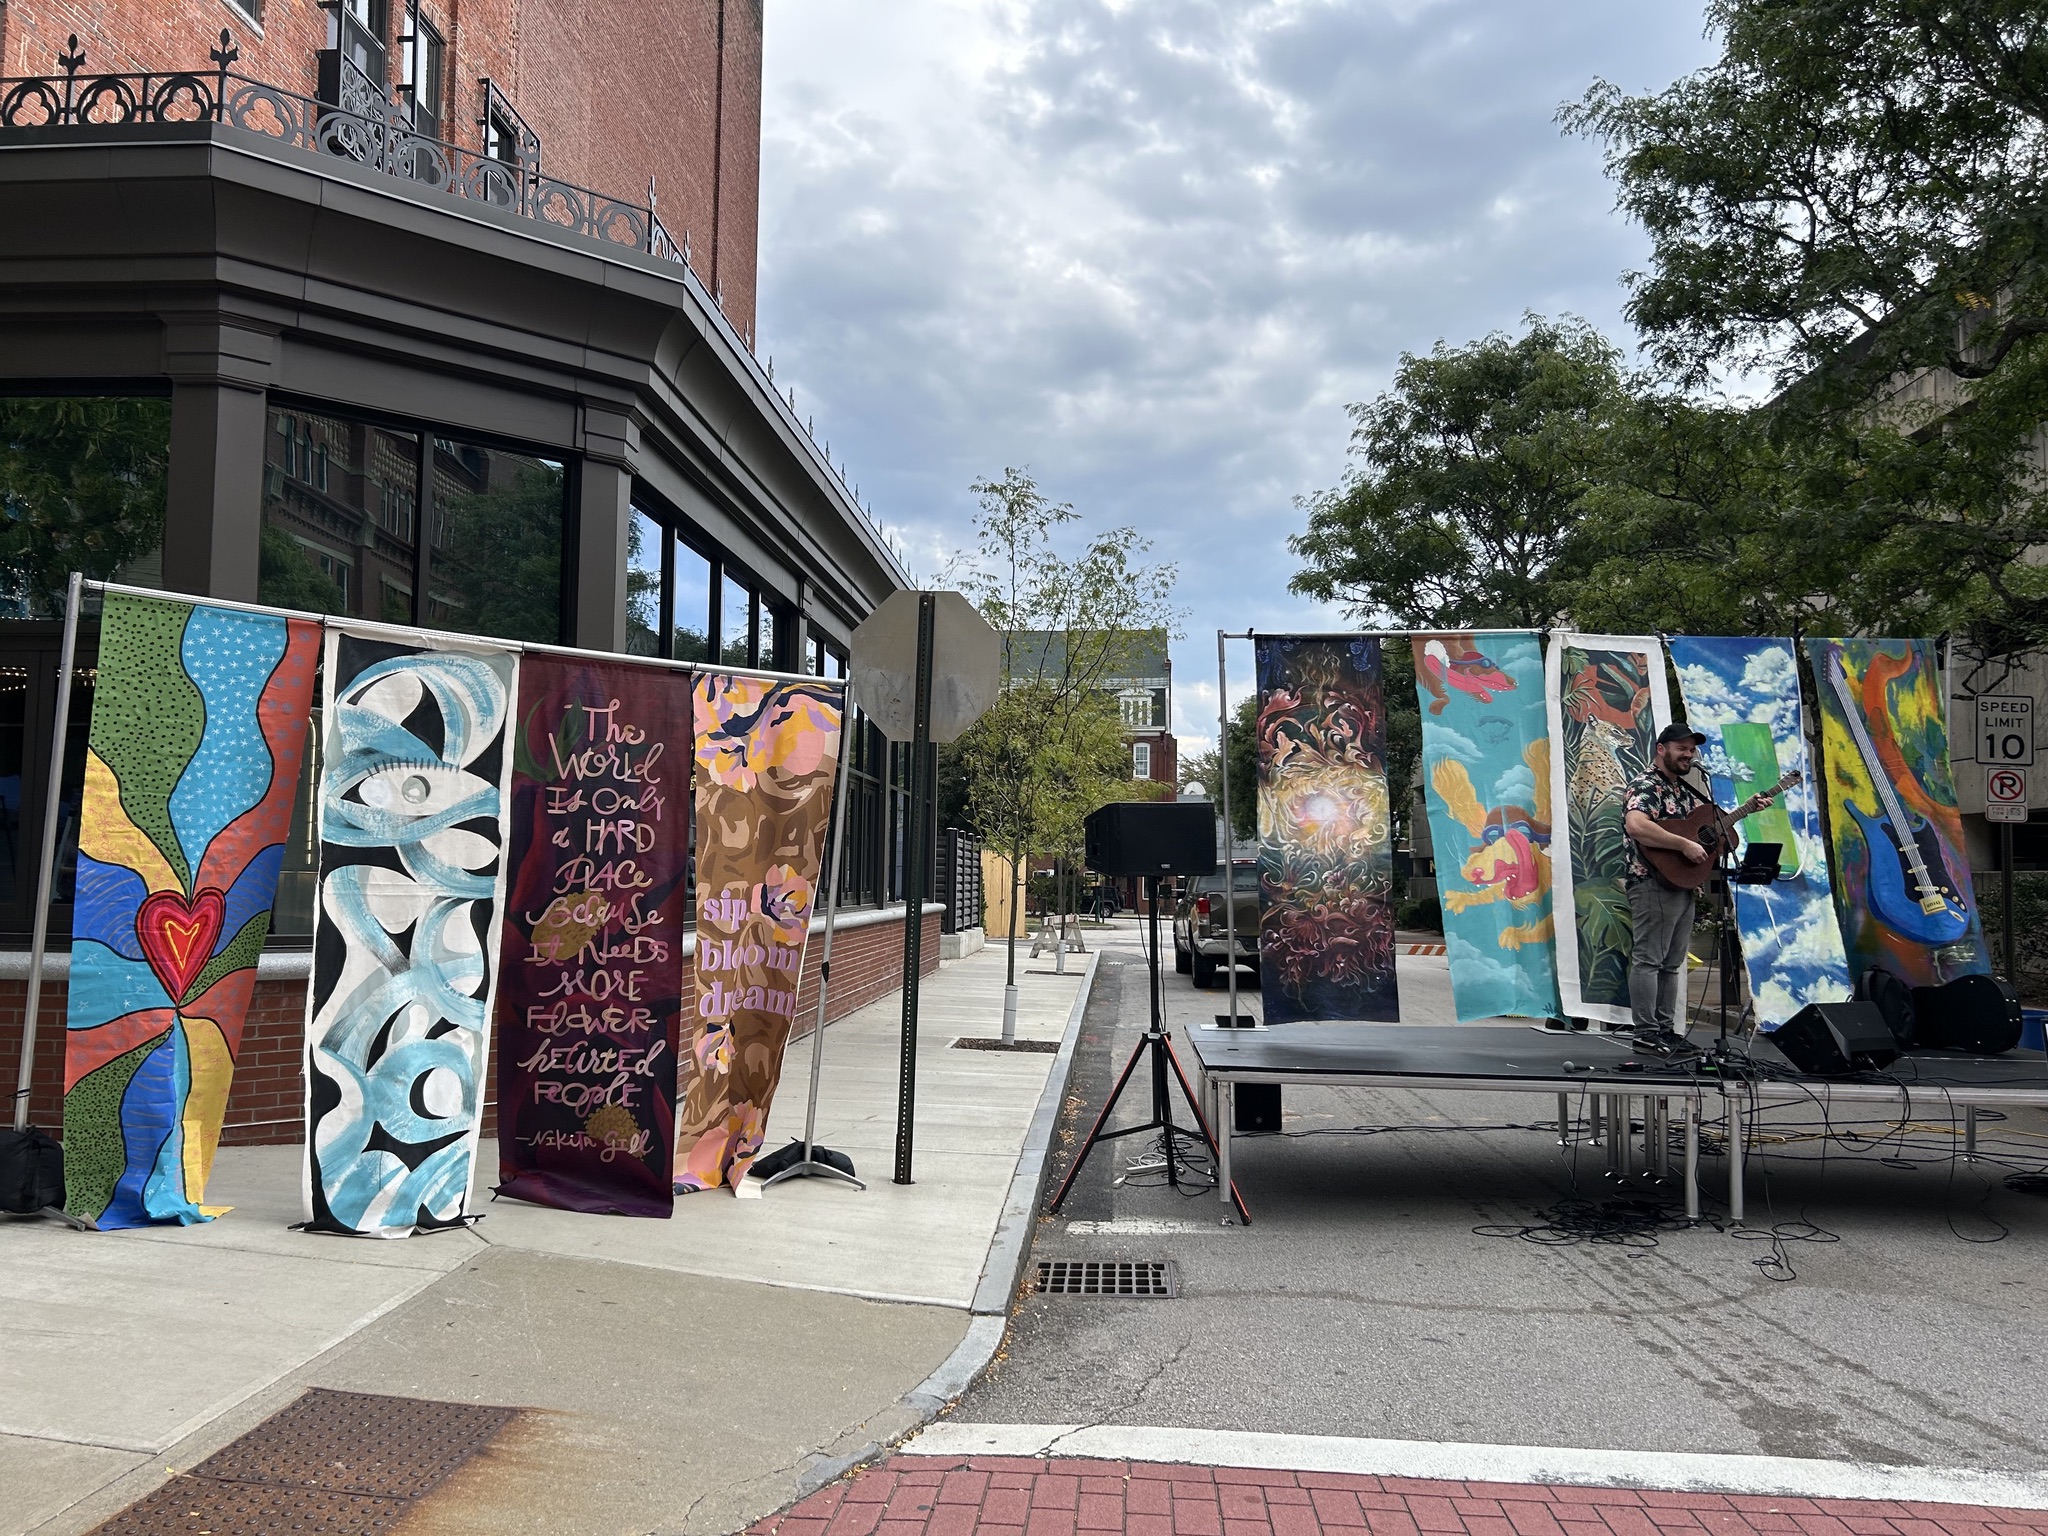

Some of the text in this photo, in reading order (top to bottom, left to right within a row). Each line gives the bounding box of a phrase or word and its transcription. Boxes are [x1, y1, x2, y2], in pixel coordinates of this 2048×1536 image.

[564, 698, 645, 745] The
[1980, 701, 2029, 713] SPEED
[1985, 717, 2024, 728] LIMIT
[1986, 733, 2025, 760] 10
[545, 785, 666, 821] Is Only
[551, 818, 656, 855] a HARD
[701, 939, 799, 972] bloom
